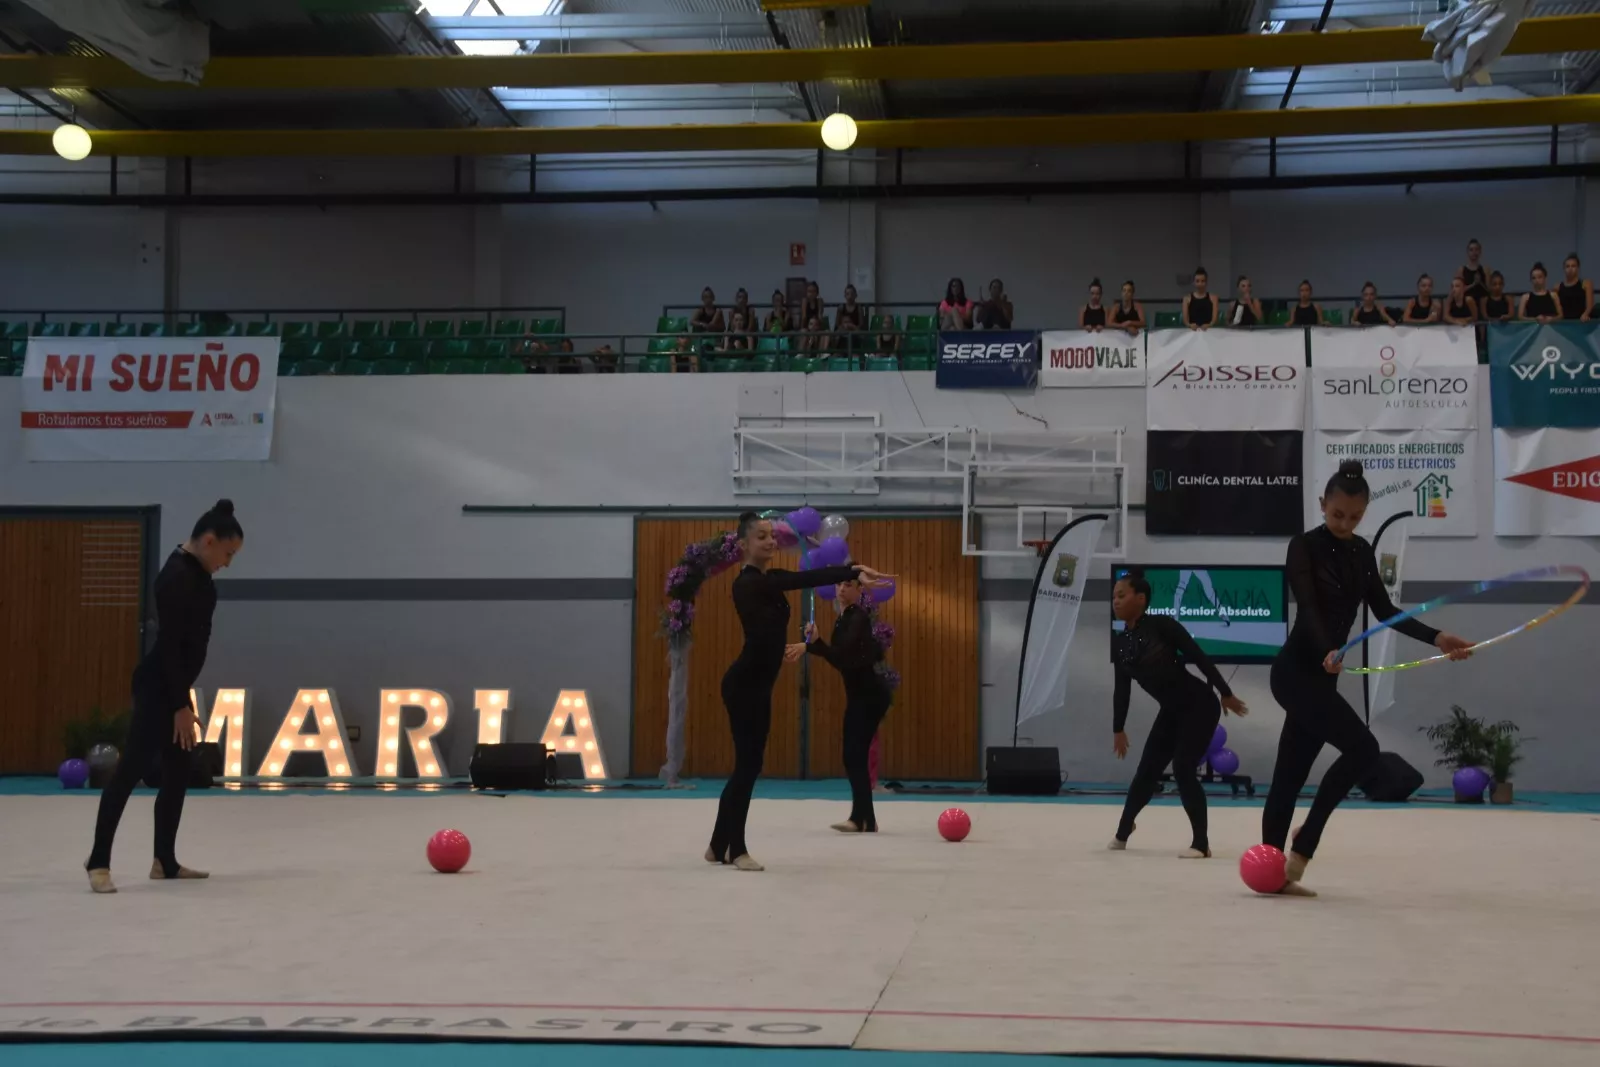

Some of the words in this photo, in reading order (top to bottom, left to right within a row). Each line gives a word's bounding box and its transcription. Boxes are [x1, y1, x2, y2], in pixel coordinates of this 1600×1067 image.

[942, 342, 1032, 359] SERFEY
[1050, 345, 1137, 368] MODOVIAJE
[43, 354, 95, 392] MI
[108, 342, 261, 392] SUEÑO
[1153, 360, 1297, 388] ADISSEO
[1244, 383, 1297, 391] Company
[1324, 374, 1468, 395] sanLorenzo
[1550, 387, 1578, 395] PEOPLE
[1385, 399, 1468, 408] AUTOESCUELA
[38, 413, 101, 426] Rotulamos
[105, 414, 124, 426] tus
[126, 413, 168, 427] sueños
[1326, 443, 1396, 455] CERTIFICADOS
[1339, 457, 1395, 470] PYECTOS
[1397, 456, 1456, 470] ELÉCTRICOS
[1222, 475, 1264, 486] DENTAL
[1266, 475, 1299, 486] LATRE
[1179, 605, 1216, 617] Senior
[1219, 605, 1271, 617] Absoluto
[190, 688, 607, 779] MARIA
[122, 1015, 823, 1034] BARBASTRO
